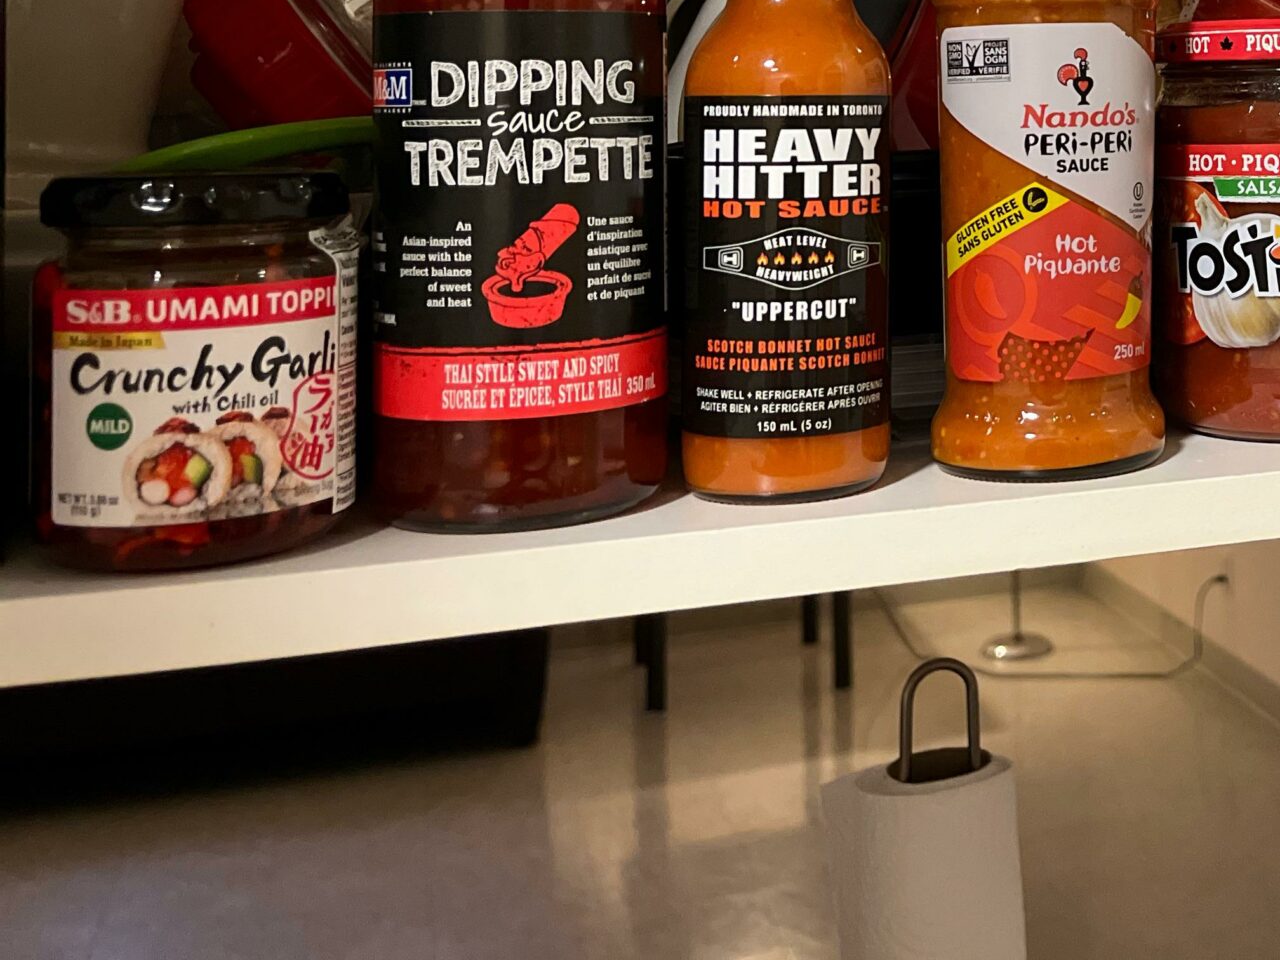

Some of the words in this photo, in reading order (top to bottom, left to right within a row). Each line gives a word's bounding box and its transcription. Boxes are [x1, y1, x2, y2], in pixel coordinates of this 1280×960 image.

[985, 47, 1007, 55] SANS
[1185, 36, 1210, 54] HOT
[430, 59, 635, 107] DIPPING
[703, 105, 750, 117] PROUDLY
[752, 104, 824, 116] HANDMADE
[826, 104, 840, 116] IN
[842, 104, 883, 116] TORONTO
[1020, 102, 1137, 129] Nando's
[487, 109, 586, 136] sauce
[703, 128, 881, 163] HEAVY
[404, 135, 653, 186] TREMPETTE
[1056, 158, 1109, 173] SAUCE
[1189, 154, 1226, 172] HOT
[703, 163, 881, 199] HITTER
[703, 200, 765, 218] HOT
[778, 197, 881, 219] SAUCE
[456, 221, 472, 232] An
[587, 216, 607, 227] Une
[609, 215, 633, 226] sauce
[956, 213, 990, 245] GLUTEN
[988, 198, 1019, 225] FREE
[402, 236, 472, 249] Asian-inspired
[587, 229, 643, 242] d'inspiration
[763, 235, 793, 250] HEAT
[796, 235, 828, 249] LEVEL
[957, 232, 982, 259] SANS
[979, 210, 1024, 245] GLUTEN
[1055, 233, 1098, 254] Hot
[402, 252, 425, 262] sauce
[428, 251, 452, 262] with
[454, 251, 472, 262] the
[587, 244, 630, 257] asiatique
[632, 242, 648, 252] avec
[400, 266, 429, 278] perfect
[431, 266, 472, 277] balance
[587, 262, 601, 272] un
[602, 257, 641, 271] équilibre
[755, 264, 835, 282] HEAVYWEIGHT
[1024, 253, 1121, 280] Piquante
[428, 282, 438, 292] of
[440, 282, 472, 292] sweet
[587, 274, 620, 288] parfait
[621, 274, 632, 283] de
[426, 297, 446, 307] and
[448, 297, 472, 307] heat
[587, 291, 598, 301] et
[600, 290, 612, 300] de
[614, 286, 645, 300] piquant
[65, 299, 132, 325] S&B
[145, 293, 259, 325] UMAMI
[731, 297, 857, 322] "UPPERCUT"
[69, 335, 94, 347] Made
[96, 336, 111, 347] in
[114, 336, 153, 349] Japan
[707, 339, 753, 354] SCOTCH
[758, 339, 812, 354] BONNET
[816, 337, 841, 351] HOT
[845, 332, 876, 349] SAUCE
[1113, 344, 1134, 360] 250
[70, 343, 244, 402] Crunchy
[250, 330, 335, 388] Garli
[444, 364, 472, 384] THAI
[475, 362, 515, 384] STYLE
[518, 360, 560, 382] SWEET
[562, 357, 587, 378] AND
[589, 353, 621, 376] SPICY
[695, 355, 725, 370] SAUCE
[729, 357, 794, 372] PIQUANTE
[799, 354, 850, 370] SCOTCH
[442, 385, 487, 410] SUCRÉE
[490, 389, 505, 409] ET
[558, 383, 595, 404] STYLE
[626, 376, 644, 395] 350
[696, 387, 719, 399] SHAKE
[721, 389, 744, 400] WELL
[755, 388, 824, 400] REFRIGERATE
[827, 384, 855, 397] AFTER
[171, 395, 211, 414] with
[216, 392, 256, 412] Chili
[259, 389, 279, 406] oil
[700, 401, 727, 412] AGITER
[729, 403, 751, 414] BIEN
[761, 401, 825, 414] RÉFRIGÉRER
[828, 395, 856, 410] APRÈS
[89, 418, 130, 435] MILD
[757, 420, 776, 432] 150
[780, 420, 797, 432] mL
[801, 419, 812, 433] (5
[815, 418, 832, 431] oz)
